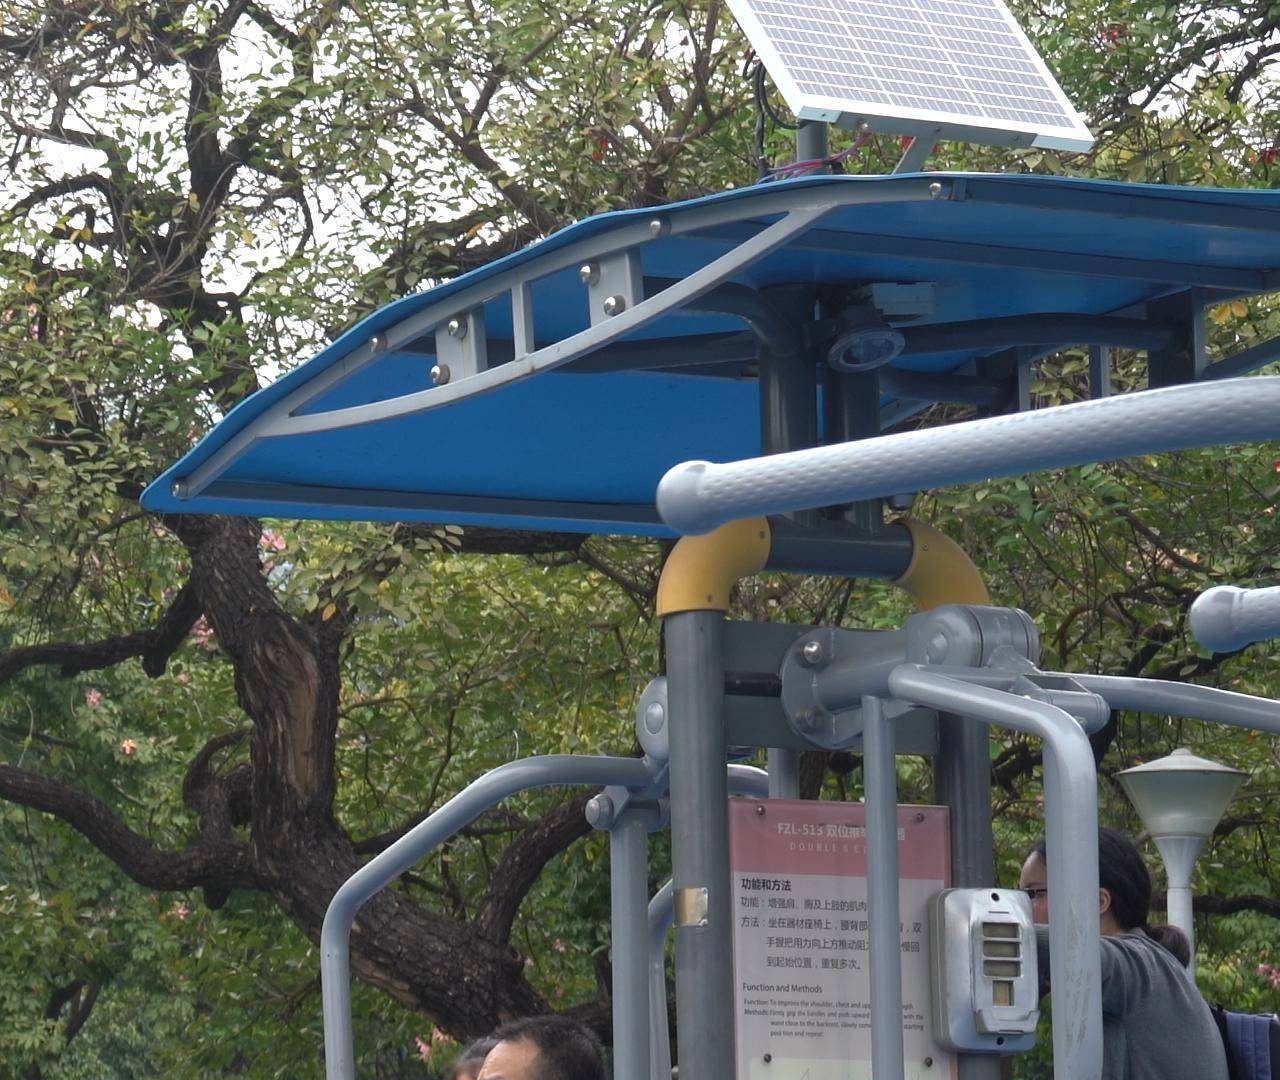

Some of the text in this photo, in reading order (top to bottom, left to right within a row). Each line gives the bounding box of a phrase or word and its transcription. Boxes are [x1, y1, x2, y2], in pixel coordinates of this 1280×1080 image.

[741, 878, 791, 892] 功能和方法
[742, 982, 823, 994] Function and Methods
